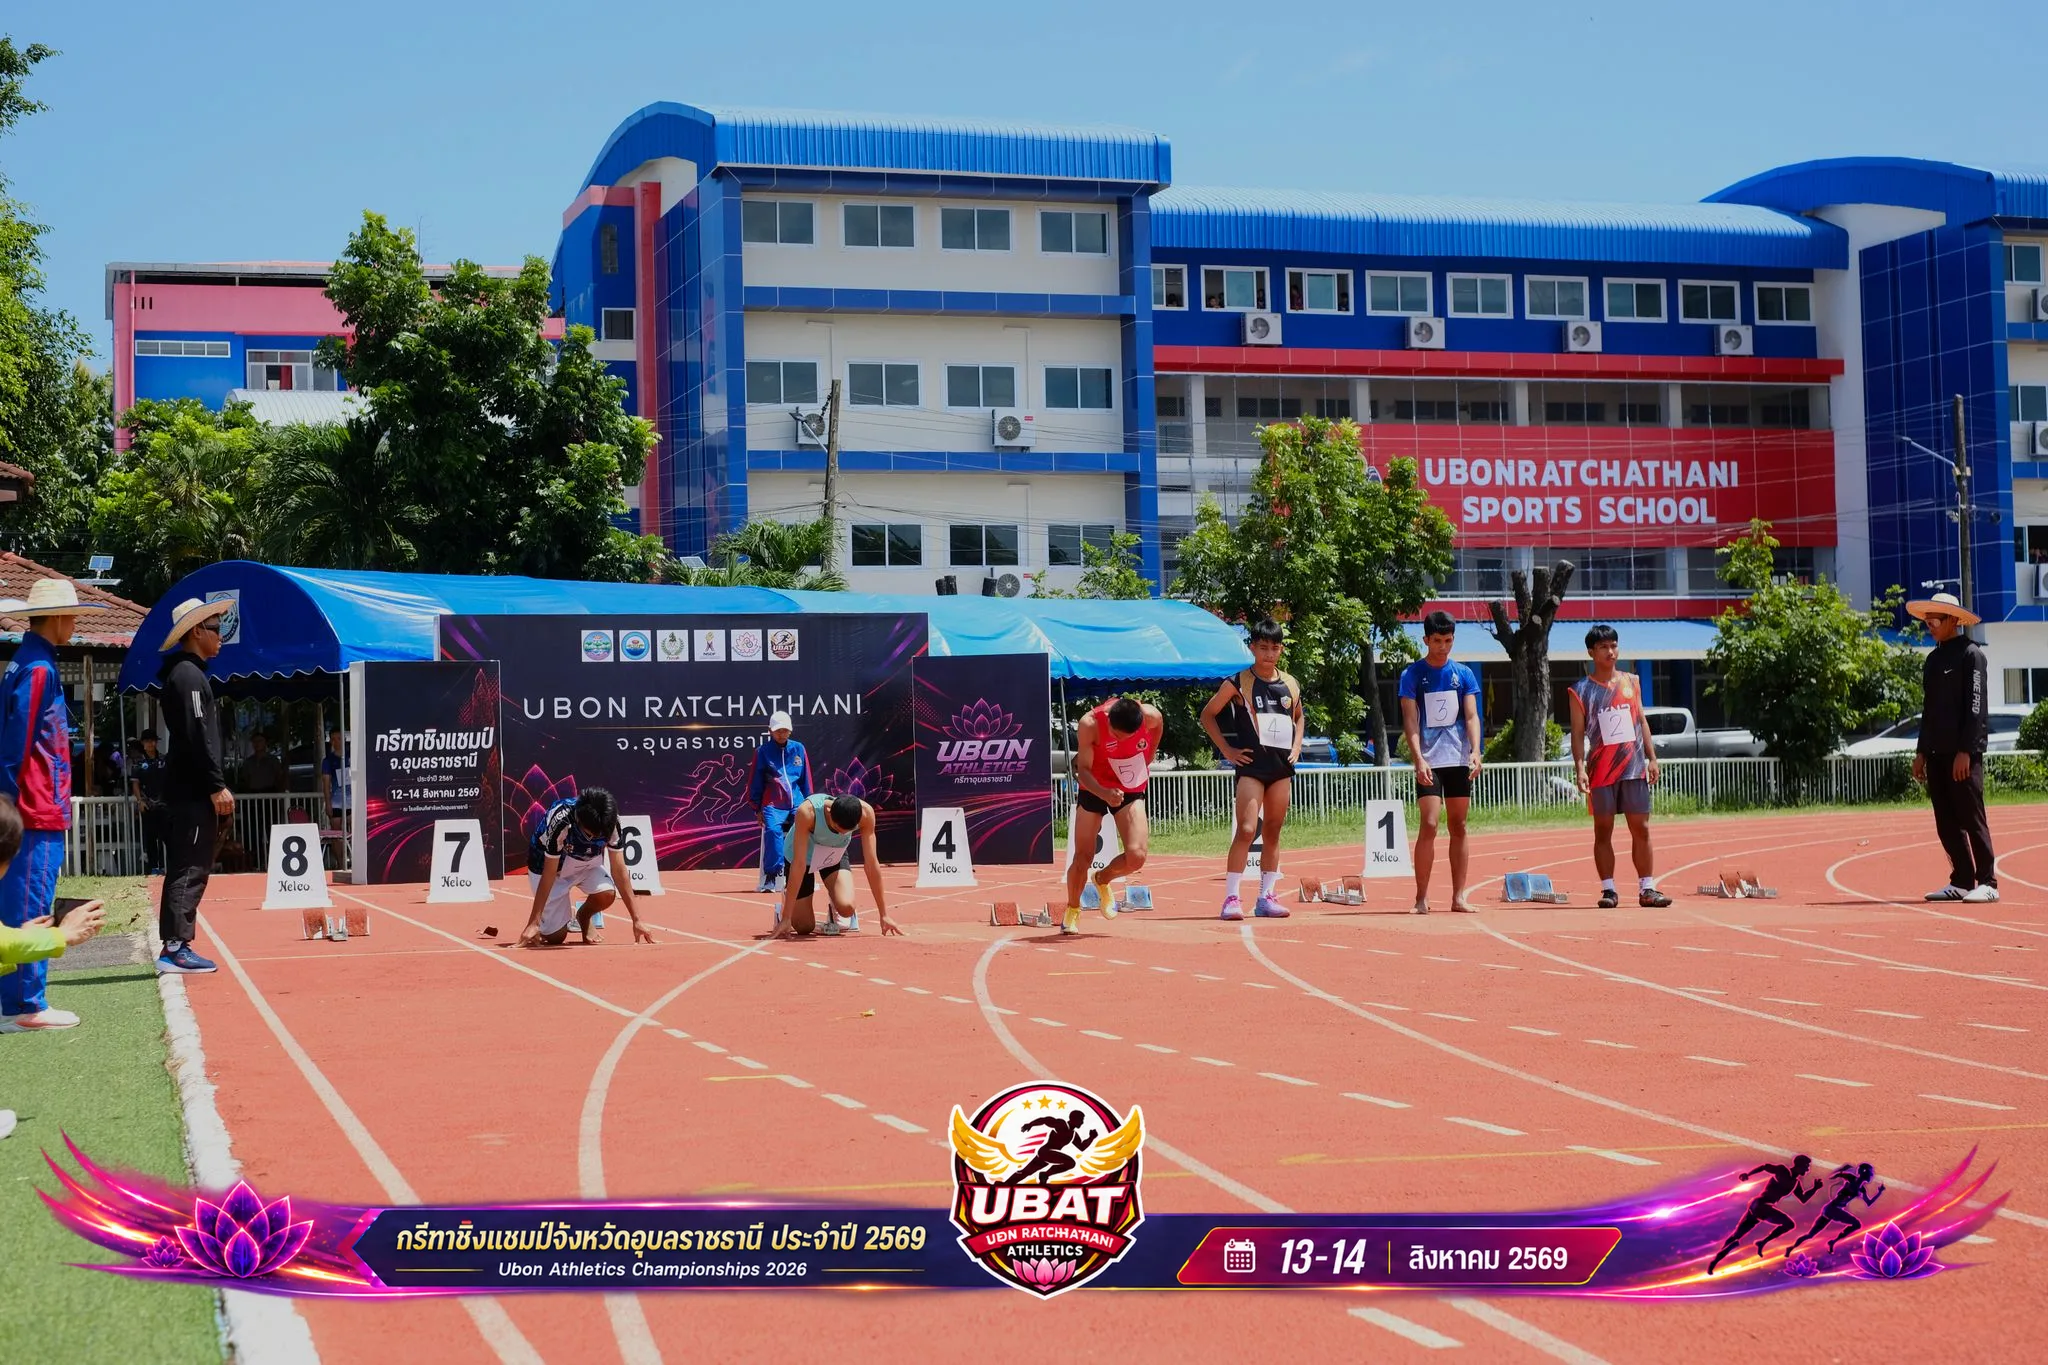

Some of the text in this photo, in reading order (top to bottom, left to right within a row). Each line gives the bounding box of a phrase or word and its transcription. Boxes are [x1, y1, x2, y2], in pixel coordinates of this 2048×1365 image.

[1424, 457, 1739, 488] UBONRATCHATHANI
[1463, 495, 1717, 525] SPORTS SCHOOL
[523, 693, 862, 720] UBON RATCHATHANI
[1435, 699, 1448, 721] 3
[1267, 717, 1281, 740] 4
[1609, 714, 1624, 737] 2
[936, 738, 1034, 762] UBON
[390, 752, 477, 774] จ.อุบลราชธานี
[938, 760, 1029, 775] ATHLETICS
[1118, 764, 1136, 784] 5
[422, 788, 456, 799] สิงหาคม
[457, 787, 480, 797] 2569
[932, 820, 956, 859] 4
[1377, 811, 1394, 849] 1
[281, 835, 309, 877] 8
[444, 832, 471, 873] 7
[621, 826, 643, 866] 6
[1372, 851, 1399, 863] Nelco
[929, 862, 958, 874] Nelco
[278, 880, 311, 892] Nelco
[441, 876, 472, 888] Nelco
